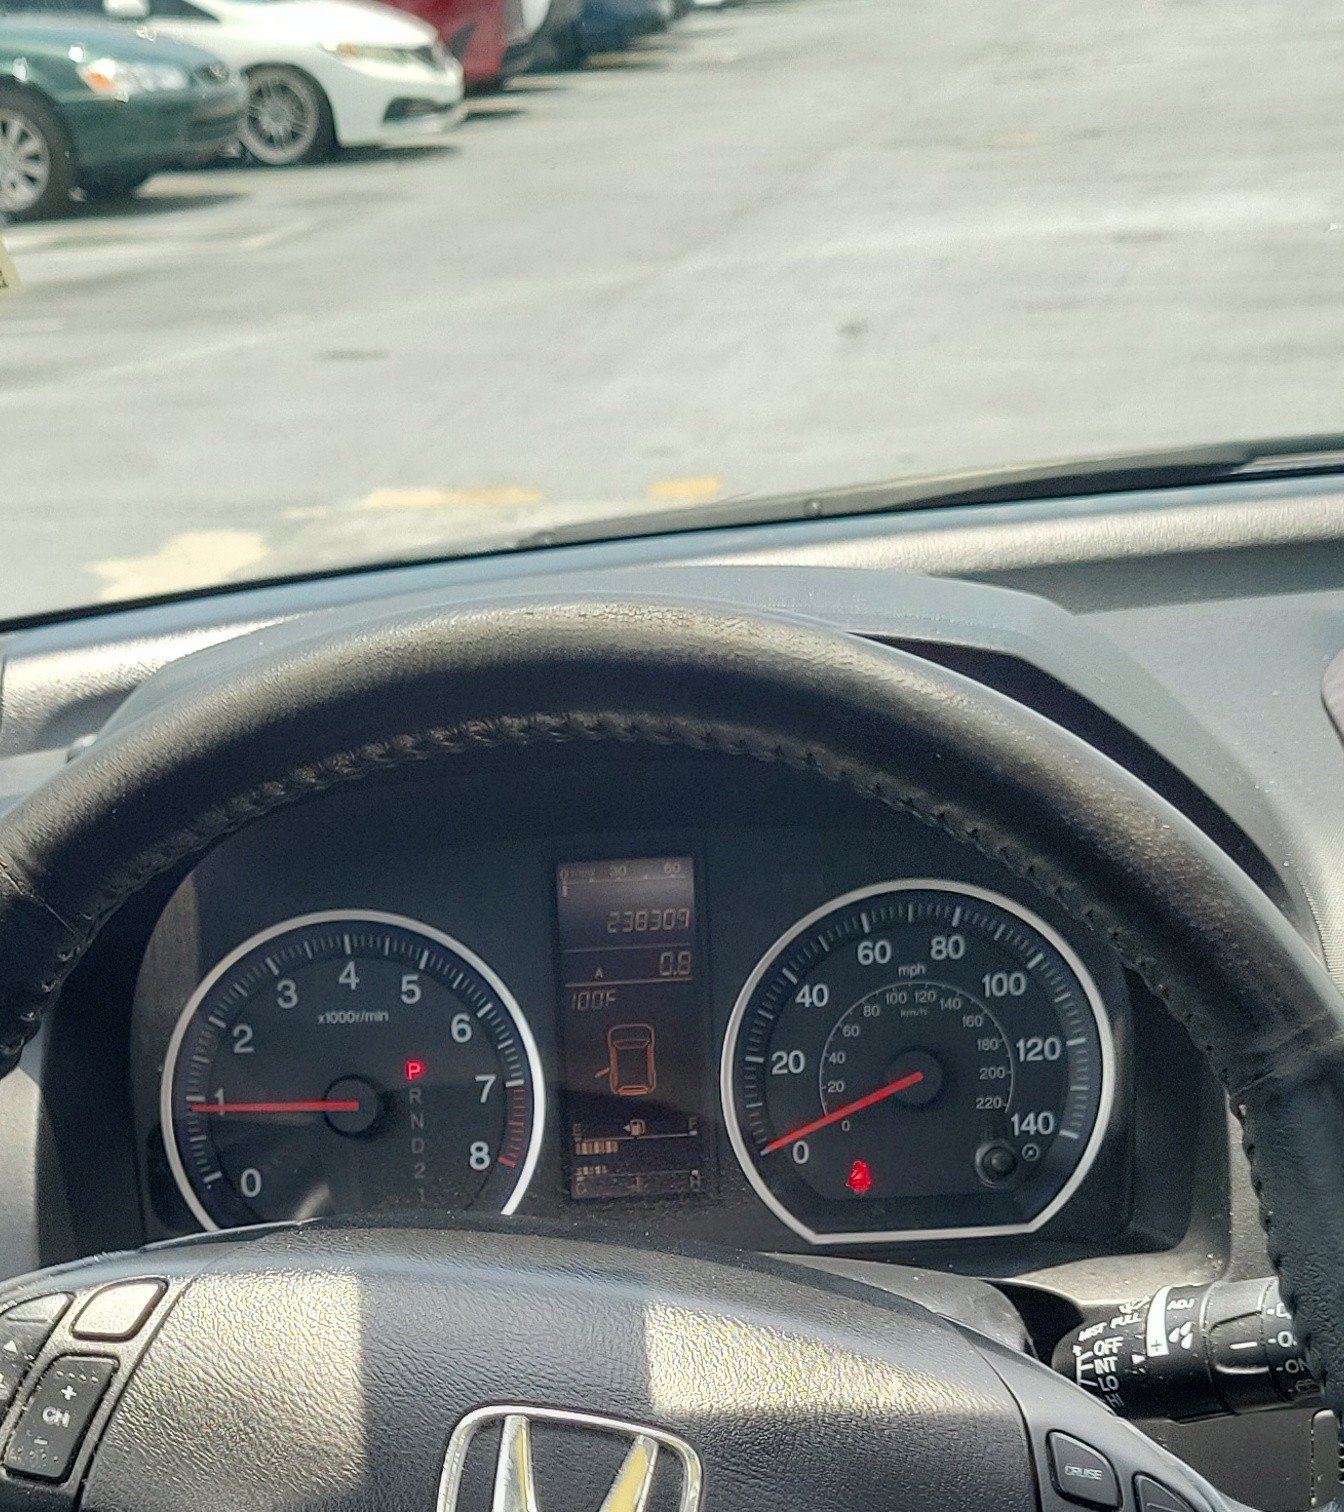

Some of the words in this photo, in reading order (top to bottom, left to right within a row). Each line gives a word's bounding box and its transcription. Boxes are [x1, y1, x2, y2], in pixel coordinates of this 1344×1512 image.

[857, 939, 892, 965] 60
[930, 935, 965, 960] 80
[339, 961, 360, 989] 4
[594, 968, 604, 978] A
[898, 961, 926, 977] mph
[275, 979, 298, 1008] 3
[401, 973, 422, 1003] 5
[982, 971, 1027, 998] 100
[795, 983, 829, 1007] 40
[886, 991, 907, 1005] 100
[915, 990, 936, 1004] 120
[940, 998, 962, 1011] 140
[863, 1003, 881, 1018] 80
[450, 1013, 472, 1043] 6
[842, 1024, 860, 1038] 60
[962, 1015, 984, 1028] 160
[232, 1024, 254, 1054] 2
[977, 1038, 999, 1052] 180
[828, 1051, 846, 1065] 40
[1015, 1037, 1061, 1063] 120
[404, 1060, 425, 1080] P
[771, 1050, 806, 1075] 20
[979, 1066, 1006, 1080] 200
[475, 1074, 496, 1103] 7
[827, 1080, 845, 1094] 20
[213, 1088, 226, 1116] 1
[976, 1096, 1002, 1110] 220
[841, 1120, 851, 1132] 0
[1010, 1111, 1055, 1137] 140
[469, 1141, 491, 1170] 8
[792, 1140, 810, 1165] 0
[239, 1169, 262, 1197] 0
[1166, 1298, 1195, 1311] ADJ
[1093, 1336, 1124, 1356] OFF
[1097, 1374, 1120, 1392] LO
[42, 1406, 71, 1428] CH
[1064, 1463, 1103, 1480] CRUISE
